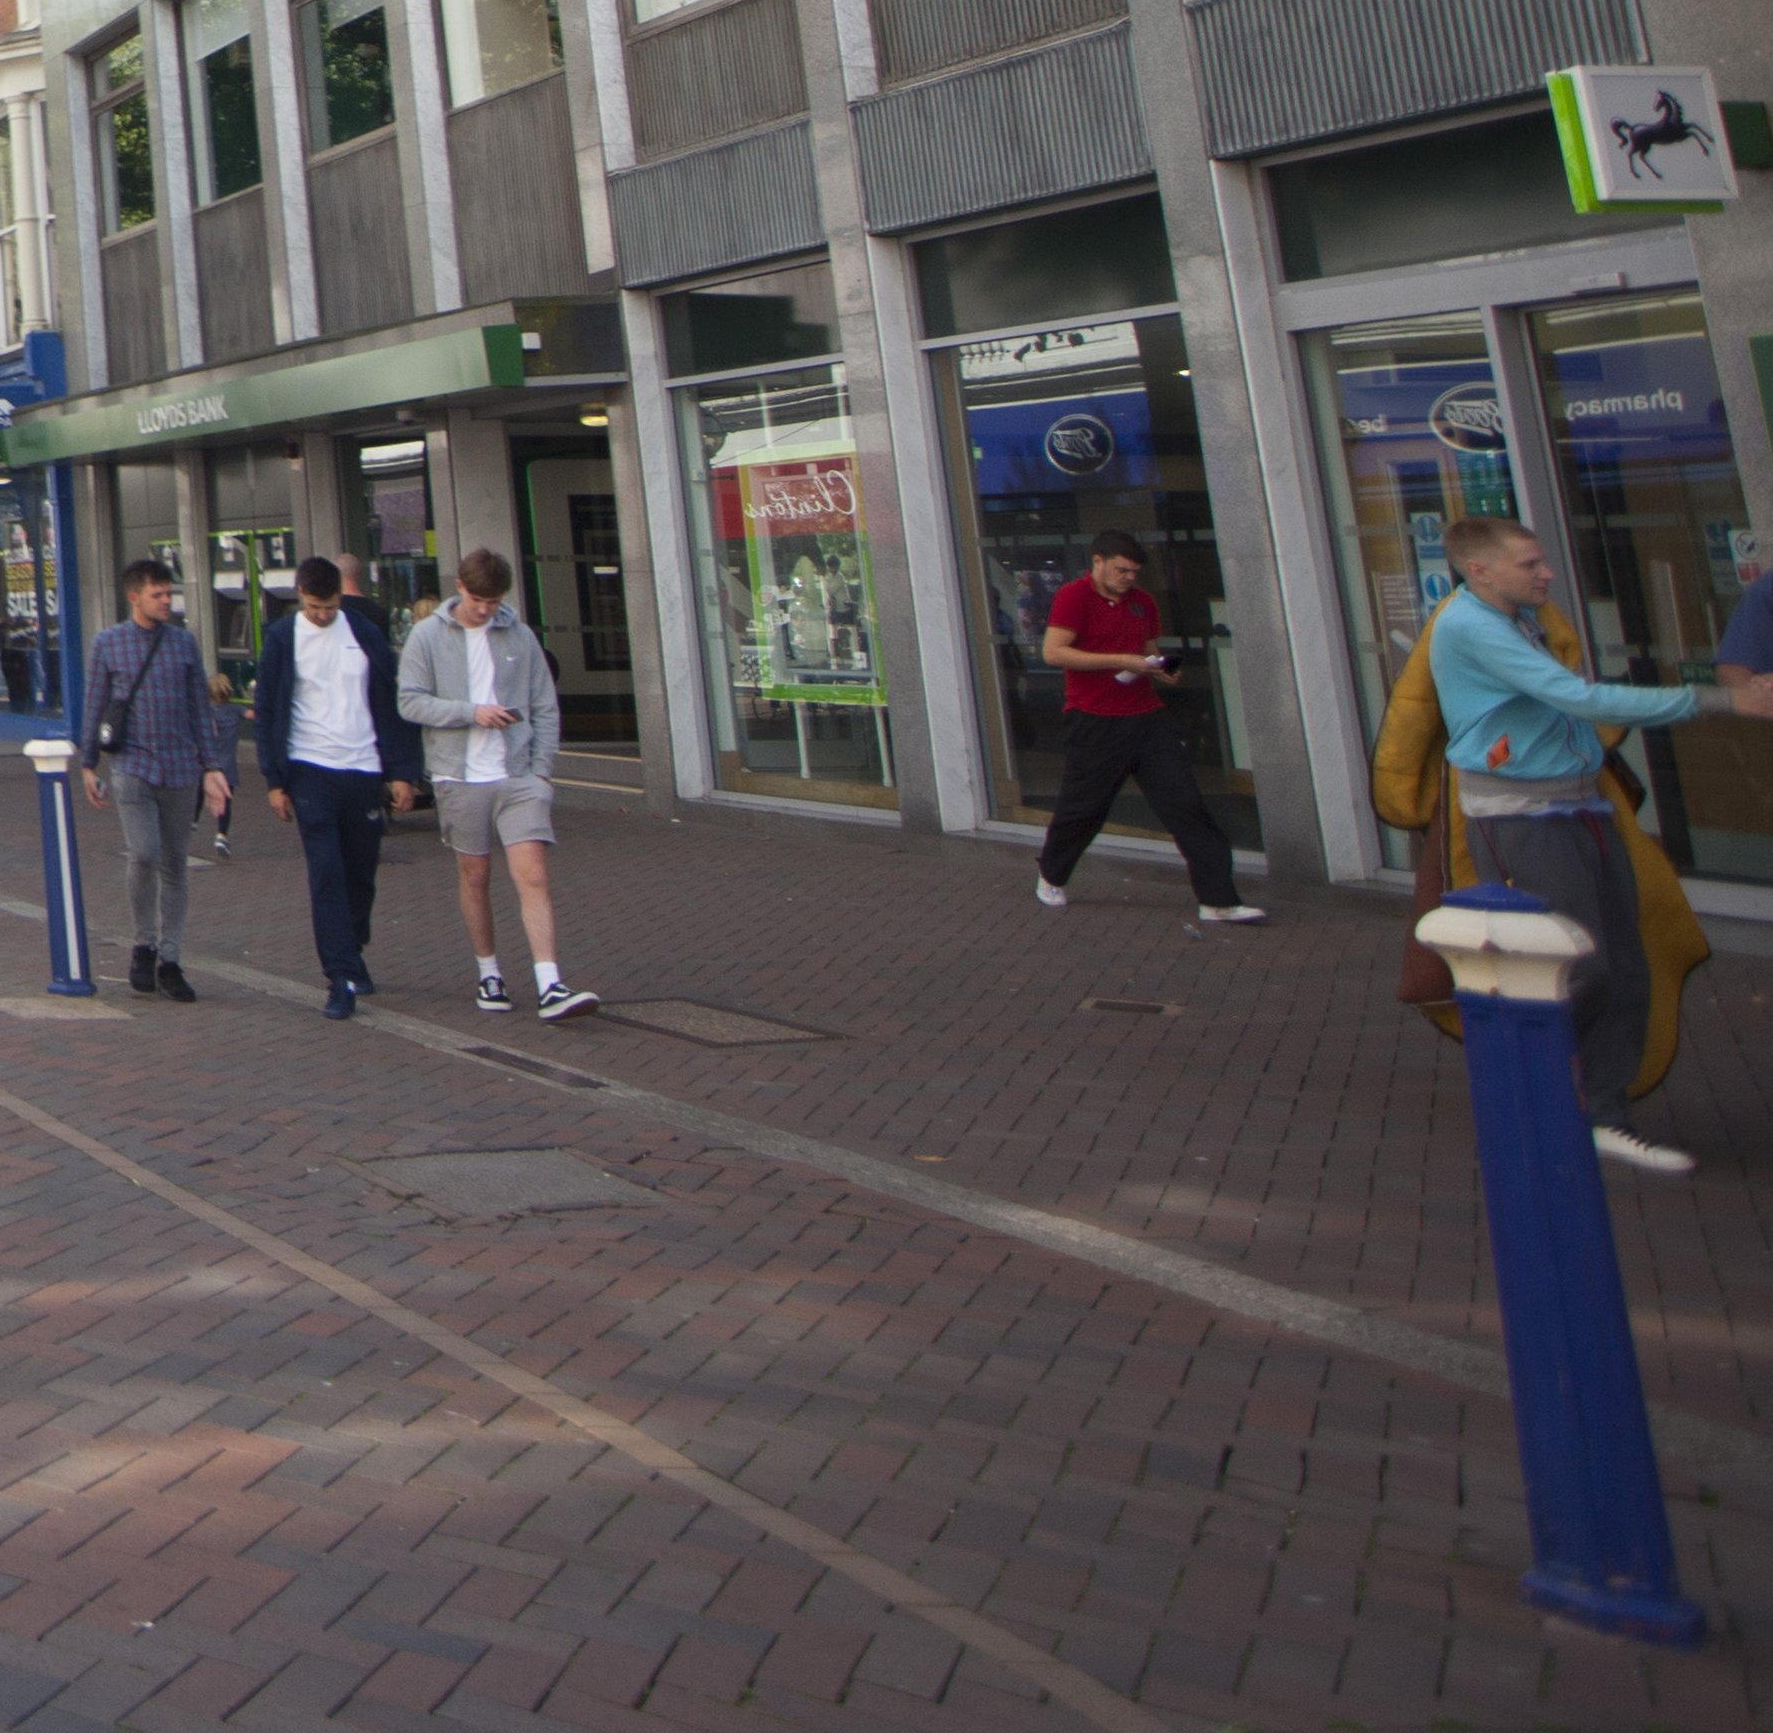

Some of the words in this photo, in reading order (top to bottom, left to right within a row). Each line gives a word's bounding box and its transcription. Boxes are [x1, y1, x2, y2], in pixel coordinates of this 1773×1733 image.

[137, 402, 187, 434] LLOYDS
[187, 395, 229, 425] BANK
[6, 591, 38, 618] SALE
